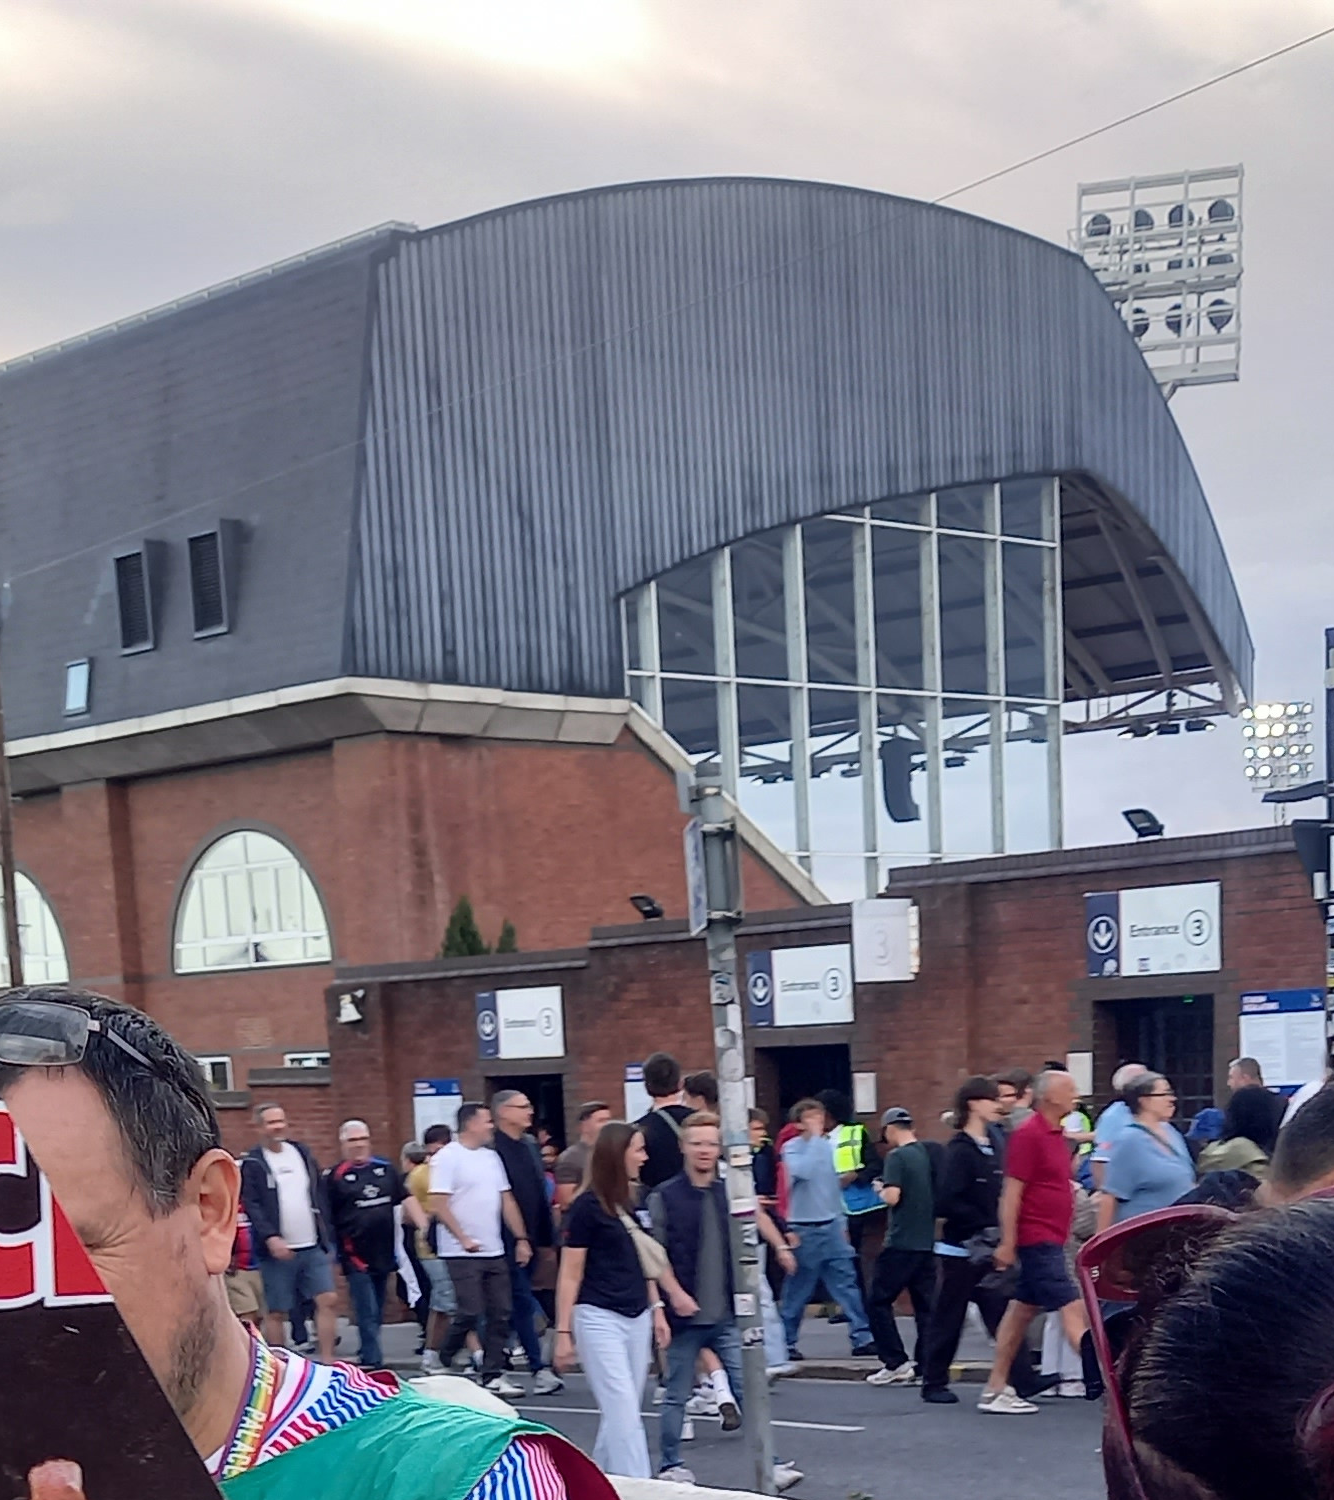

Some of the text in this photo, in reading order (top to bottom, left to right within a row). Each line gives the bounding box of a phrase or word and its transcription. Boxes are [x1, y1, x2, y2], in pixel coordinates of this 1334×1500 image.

[1130, 919, 1204, 938] Entrance 3
[829, 976, 839, 992] 3
